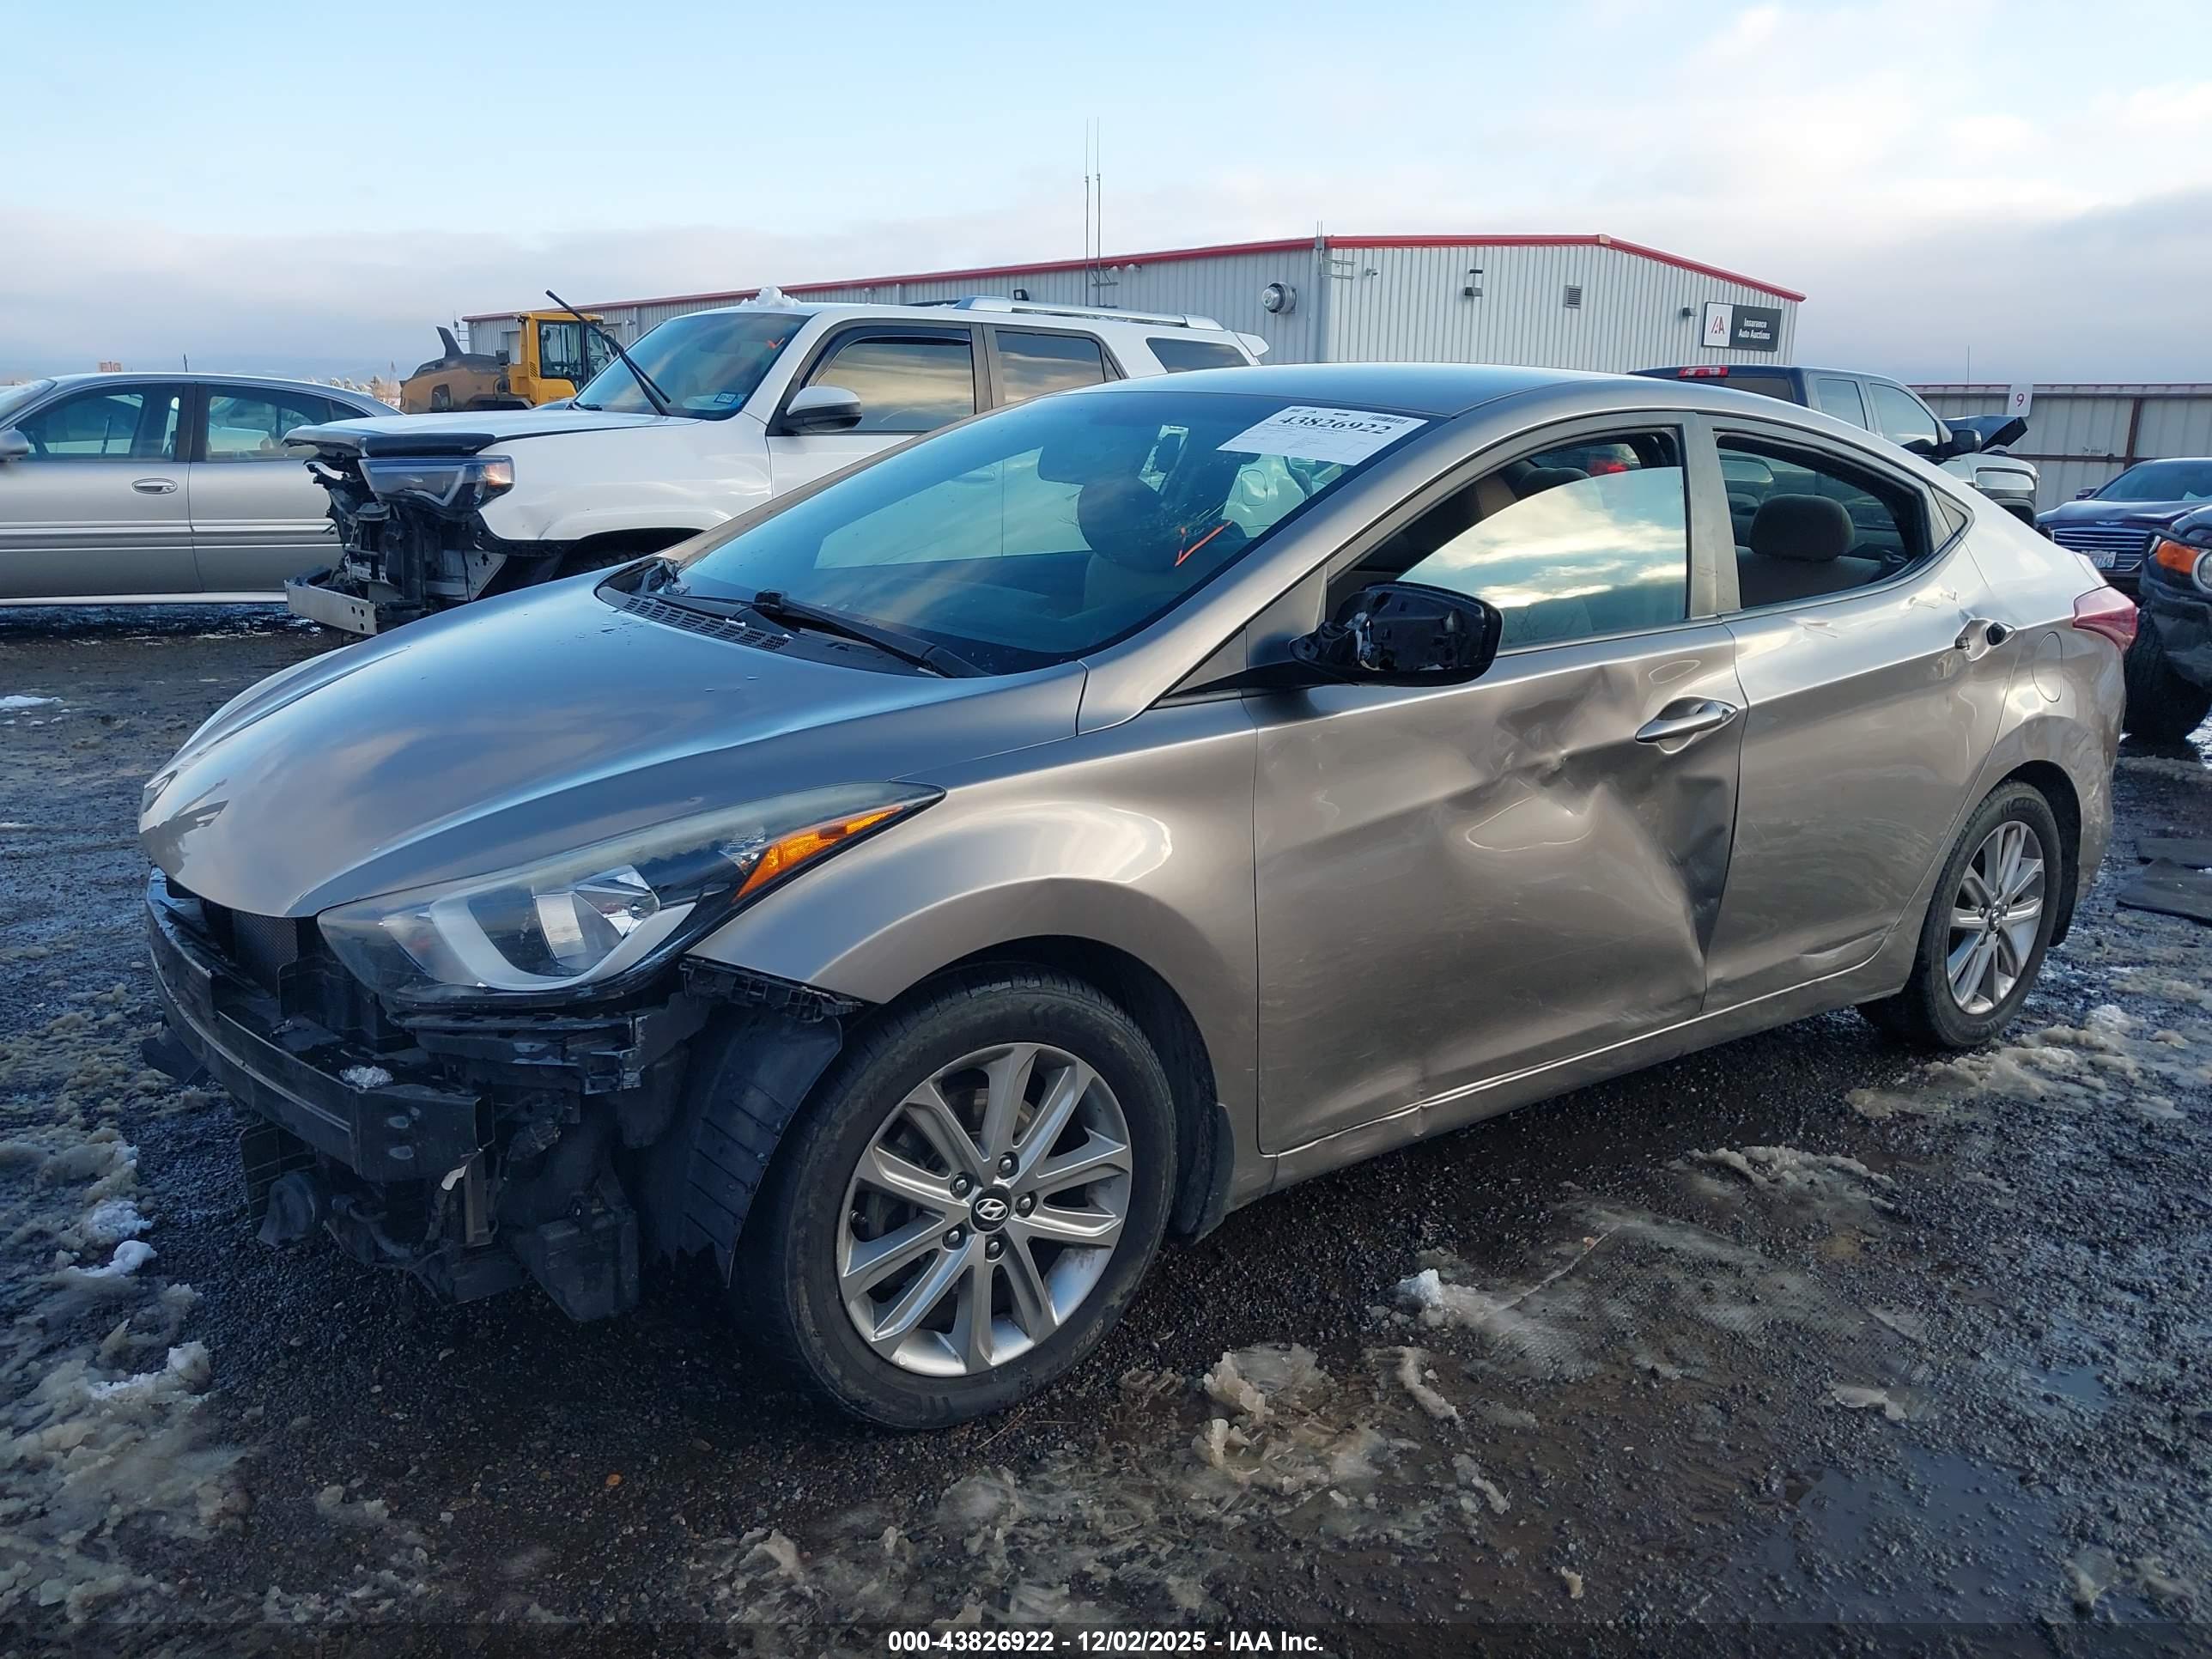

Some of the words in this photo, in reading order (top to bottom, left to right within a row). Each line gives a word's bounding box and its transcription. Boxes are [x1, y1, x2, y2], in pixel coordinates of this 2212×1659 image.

[1743, 317, 1768, 329] Insurance
[1737, 328, 1750, 338] Auto
[1749, 329, 1771, 340] Auctions
[2016, 393, 2025, 407] 9
[1279, 416, 1392, 434] 43826922
